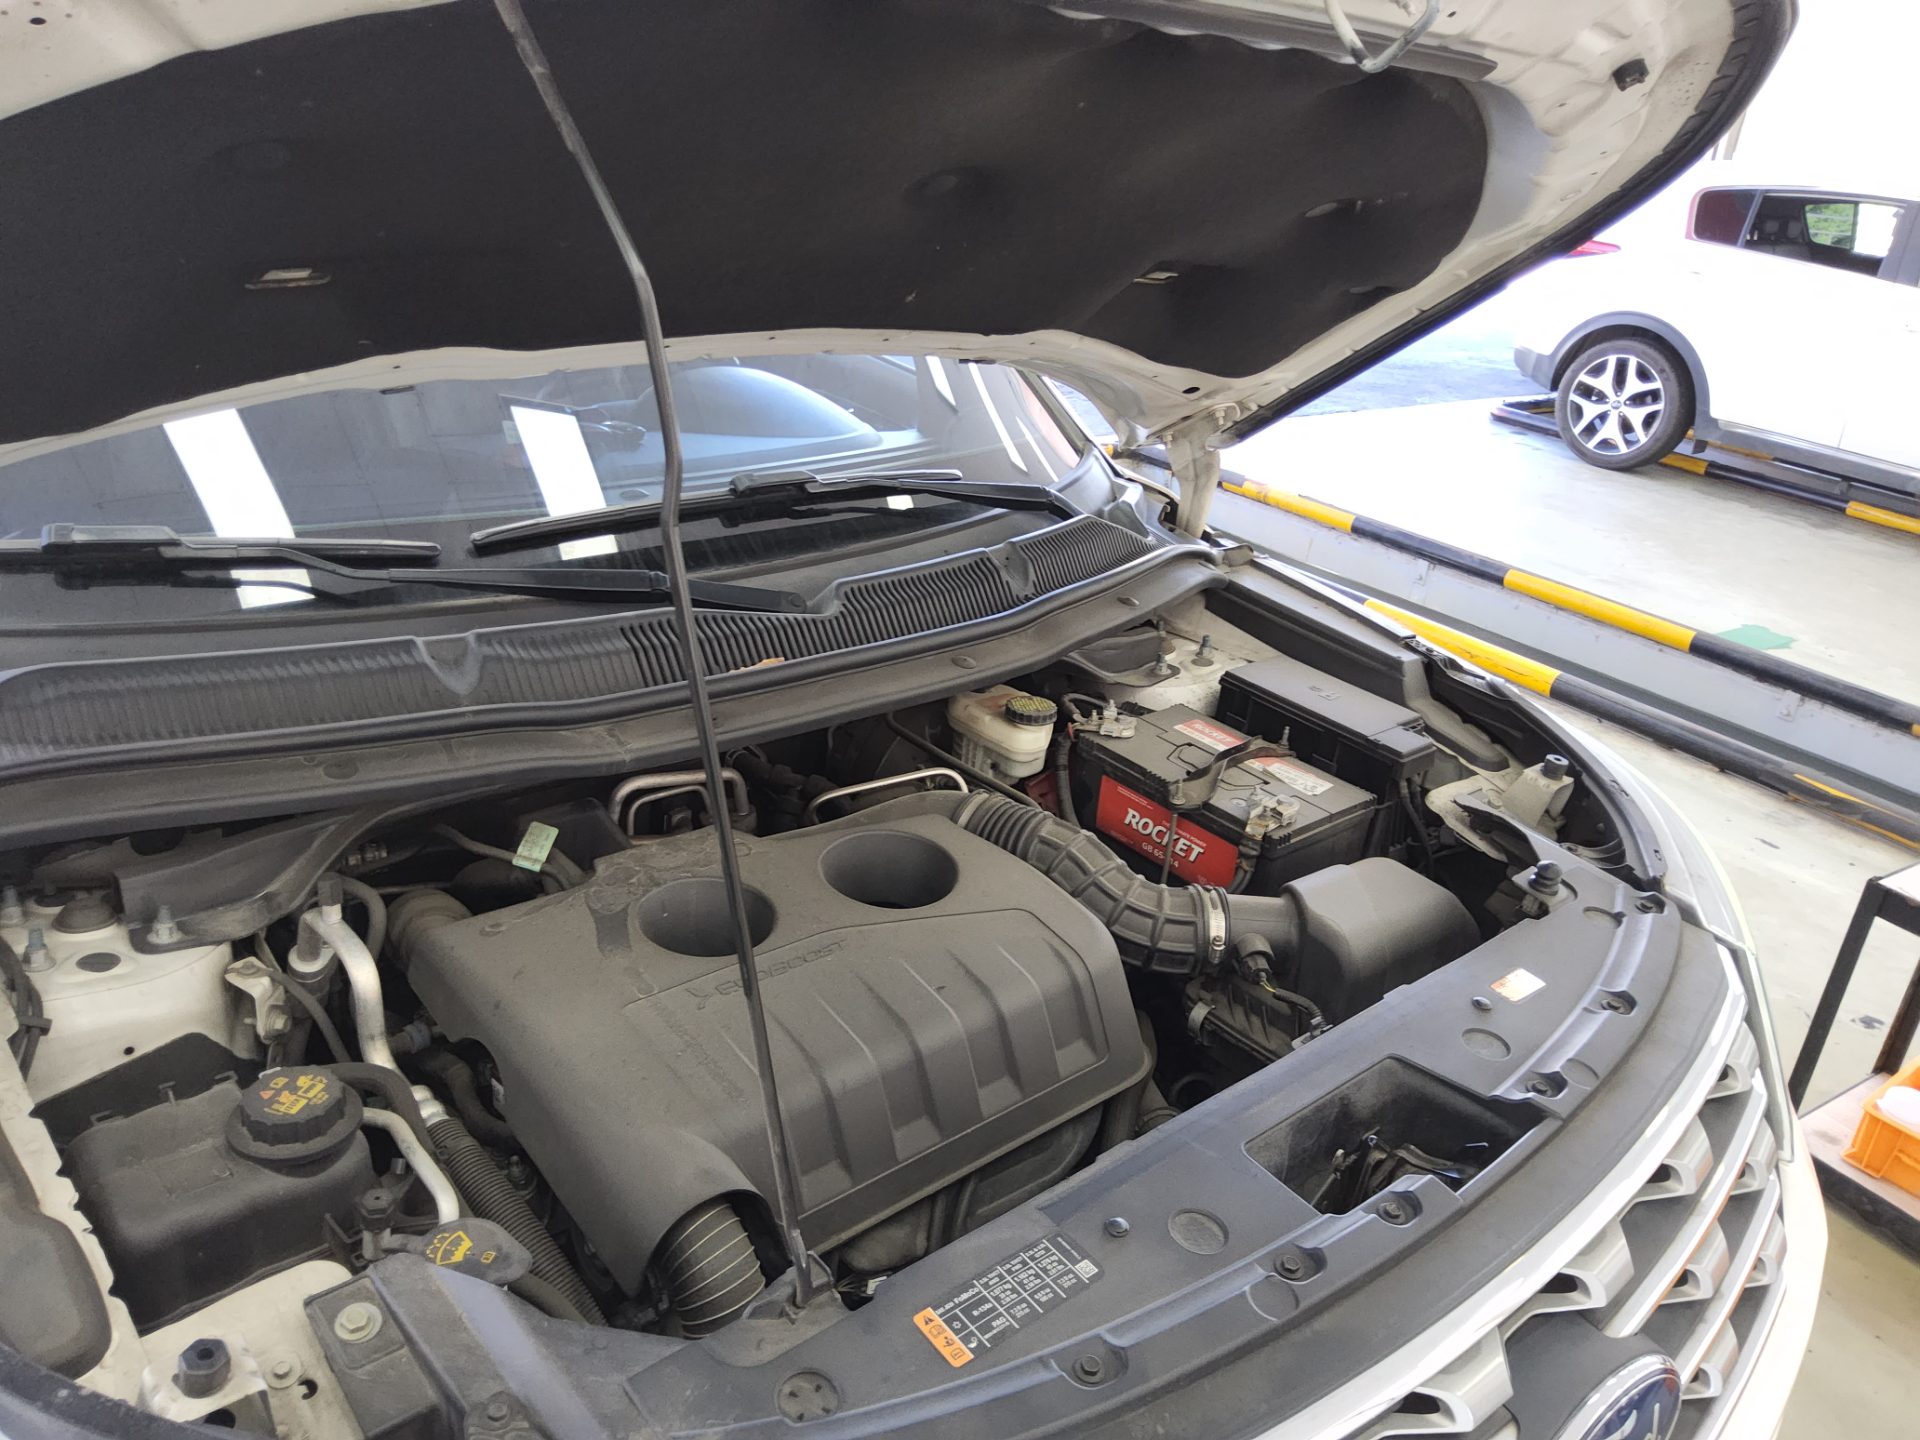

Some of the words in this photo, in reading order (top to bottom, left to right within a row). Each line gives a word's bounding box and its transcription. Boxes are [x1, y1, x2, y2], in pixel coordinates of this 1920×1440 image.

[1124, 809, 1204, 861] ROCKET
[1142, 842, 1153, 853] GB
[1153, 849, 1179, 868] 65-14
[954, 1288, 979, 1303] FoMoCo
[972, 1303, 993, 1316] R-134a
[992, 1317, 1006, 1327] PAG
